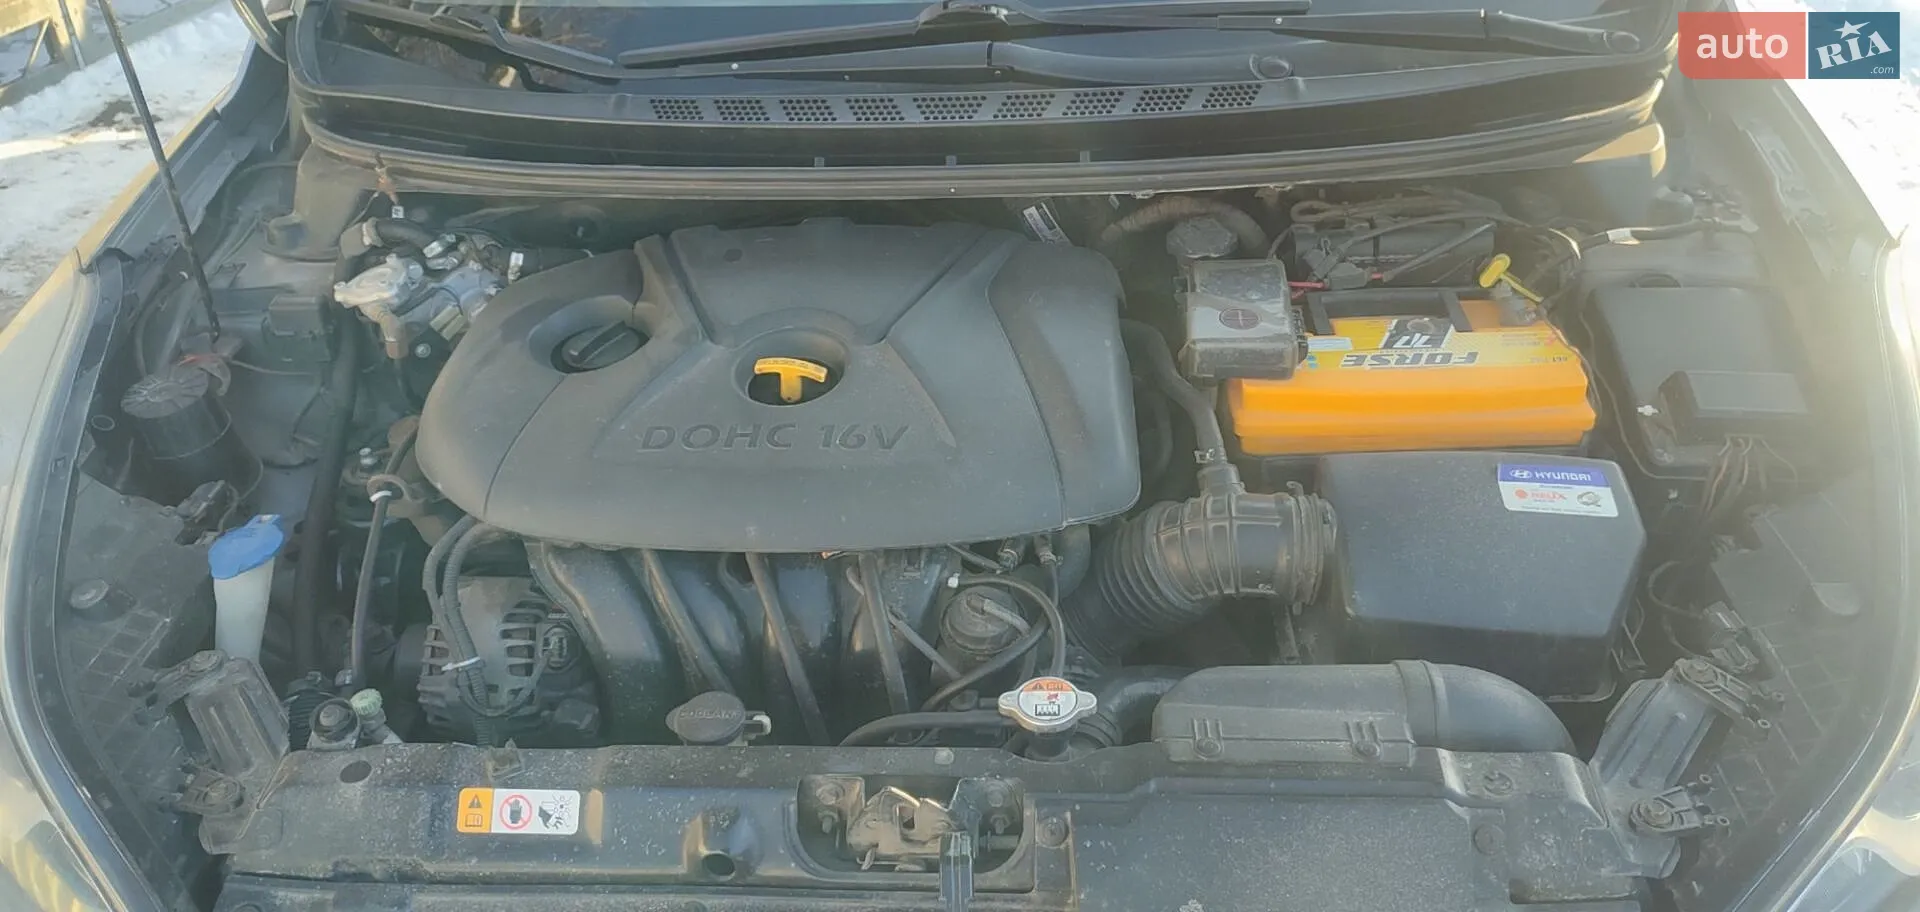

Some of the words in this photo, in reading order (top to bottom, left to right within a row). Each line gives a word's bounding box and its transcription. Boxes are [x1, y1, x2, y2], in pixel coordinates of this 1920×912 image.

[1340, 351, 1479, 368] FORSE
[640, 423, 799, 452] DOHC
[820, 422, 910, 451] 16V
[1534, 471, 1592, 482] HYUNDAI
